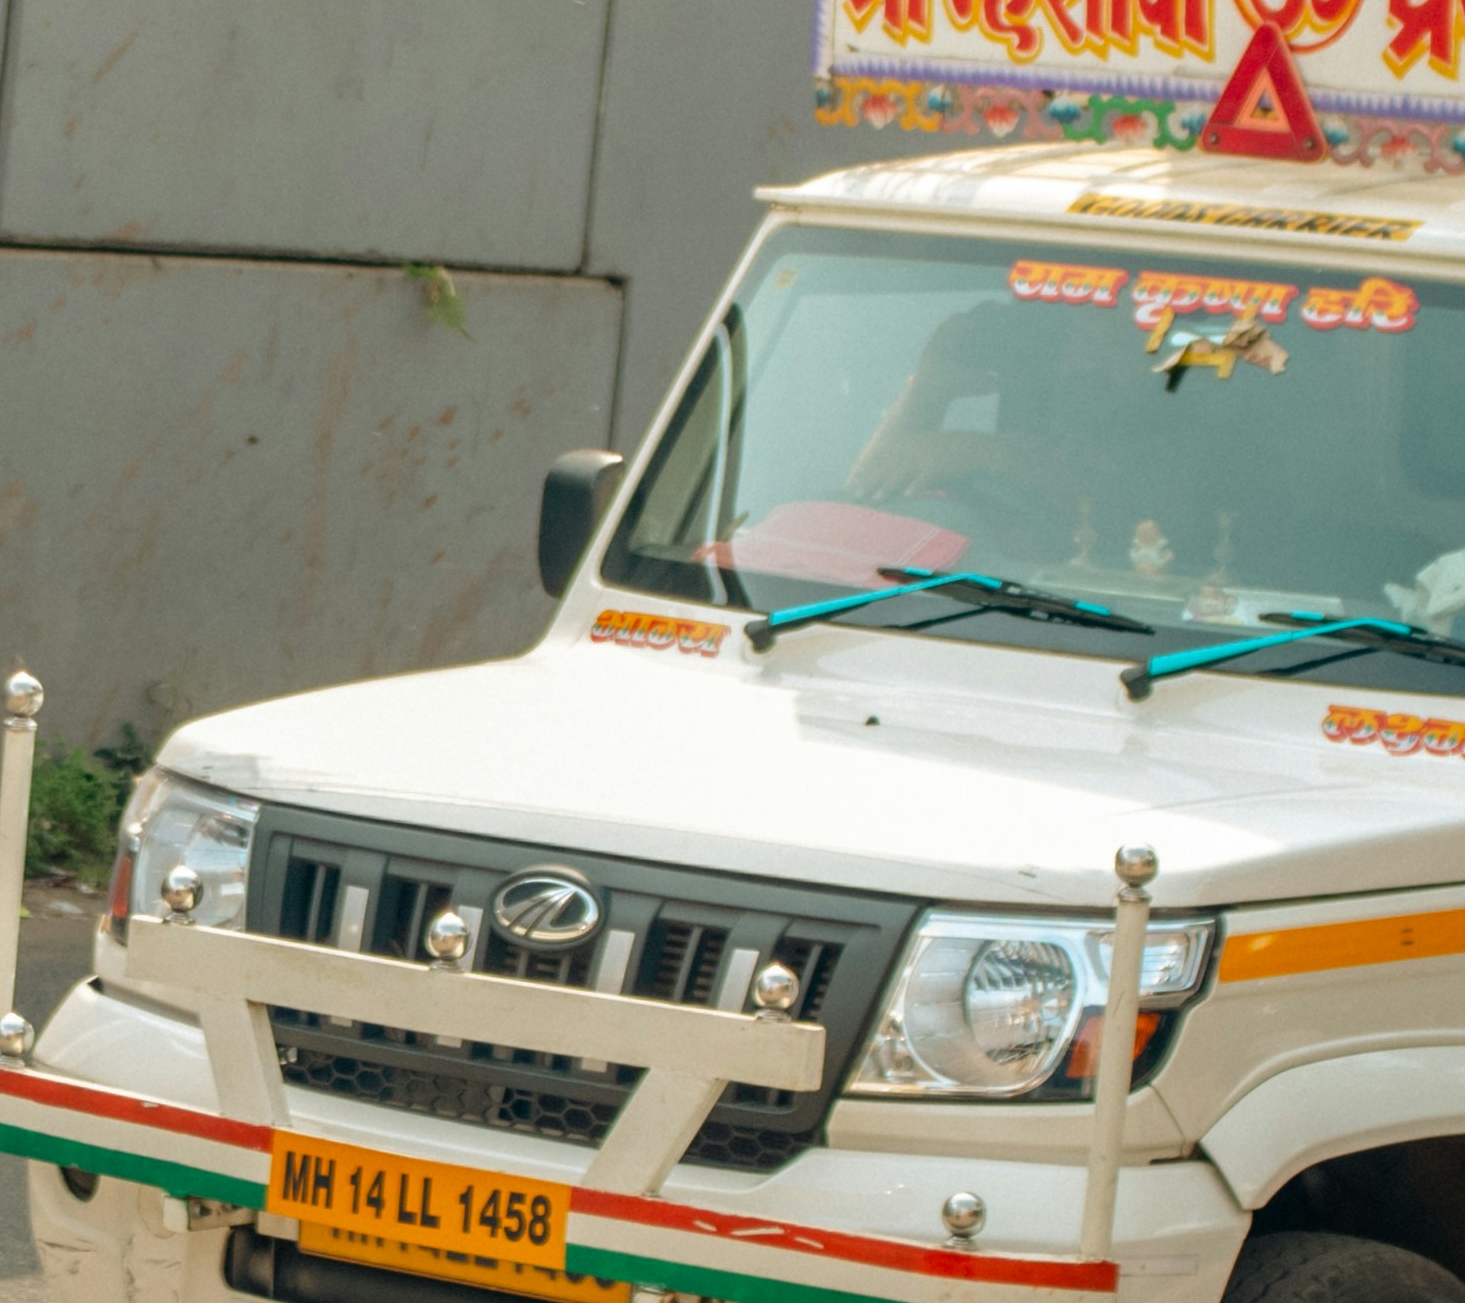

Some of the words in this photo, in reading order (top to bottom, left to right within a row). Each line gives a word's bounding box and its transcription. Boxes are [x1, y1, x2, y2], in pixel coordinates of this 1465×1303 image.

[1079, 195, 1212, 225] GOODS
[1215, 204, 1412, 241] CARRIER
[1008, 260, 1128, 302] राम
[1300, 276, 1419, 332] हरि
[281, 1150, 337, 1209] MH
[350, 1165, 386, 1219] 14
[397, 1173, 441, 1229] LL
[458, 1184, 553, 1246] 1458
